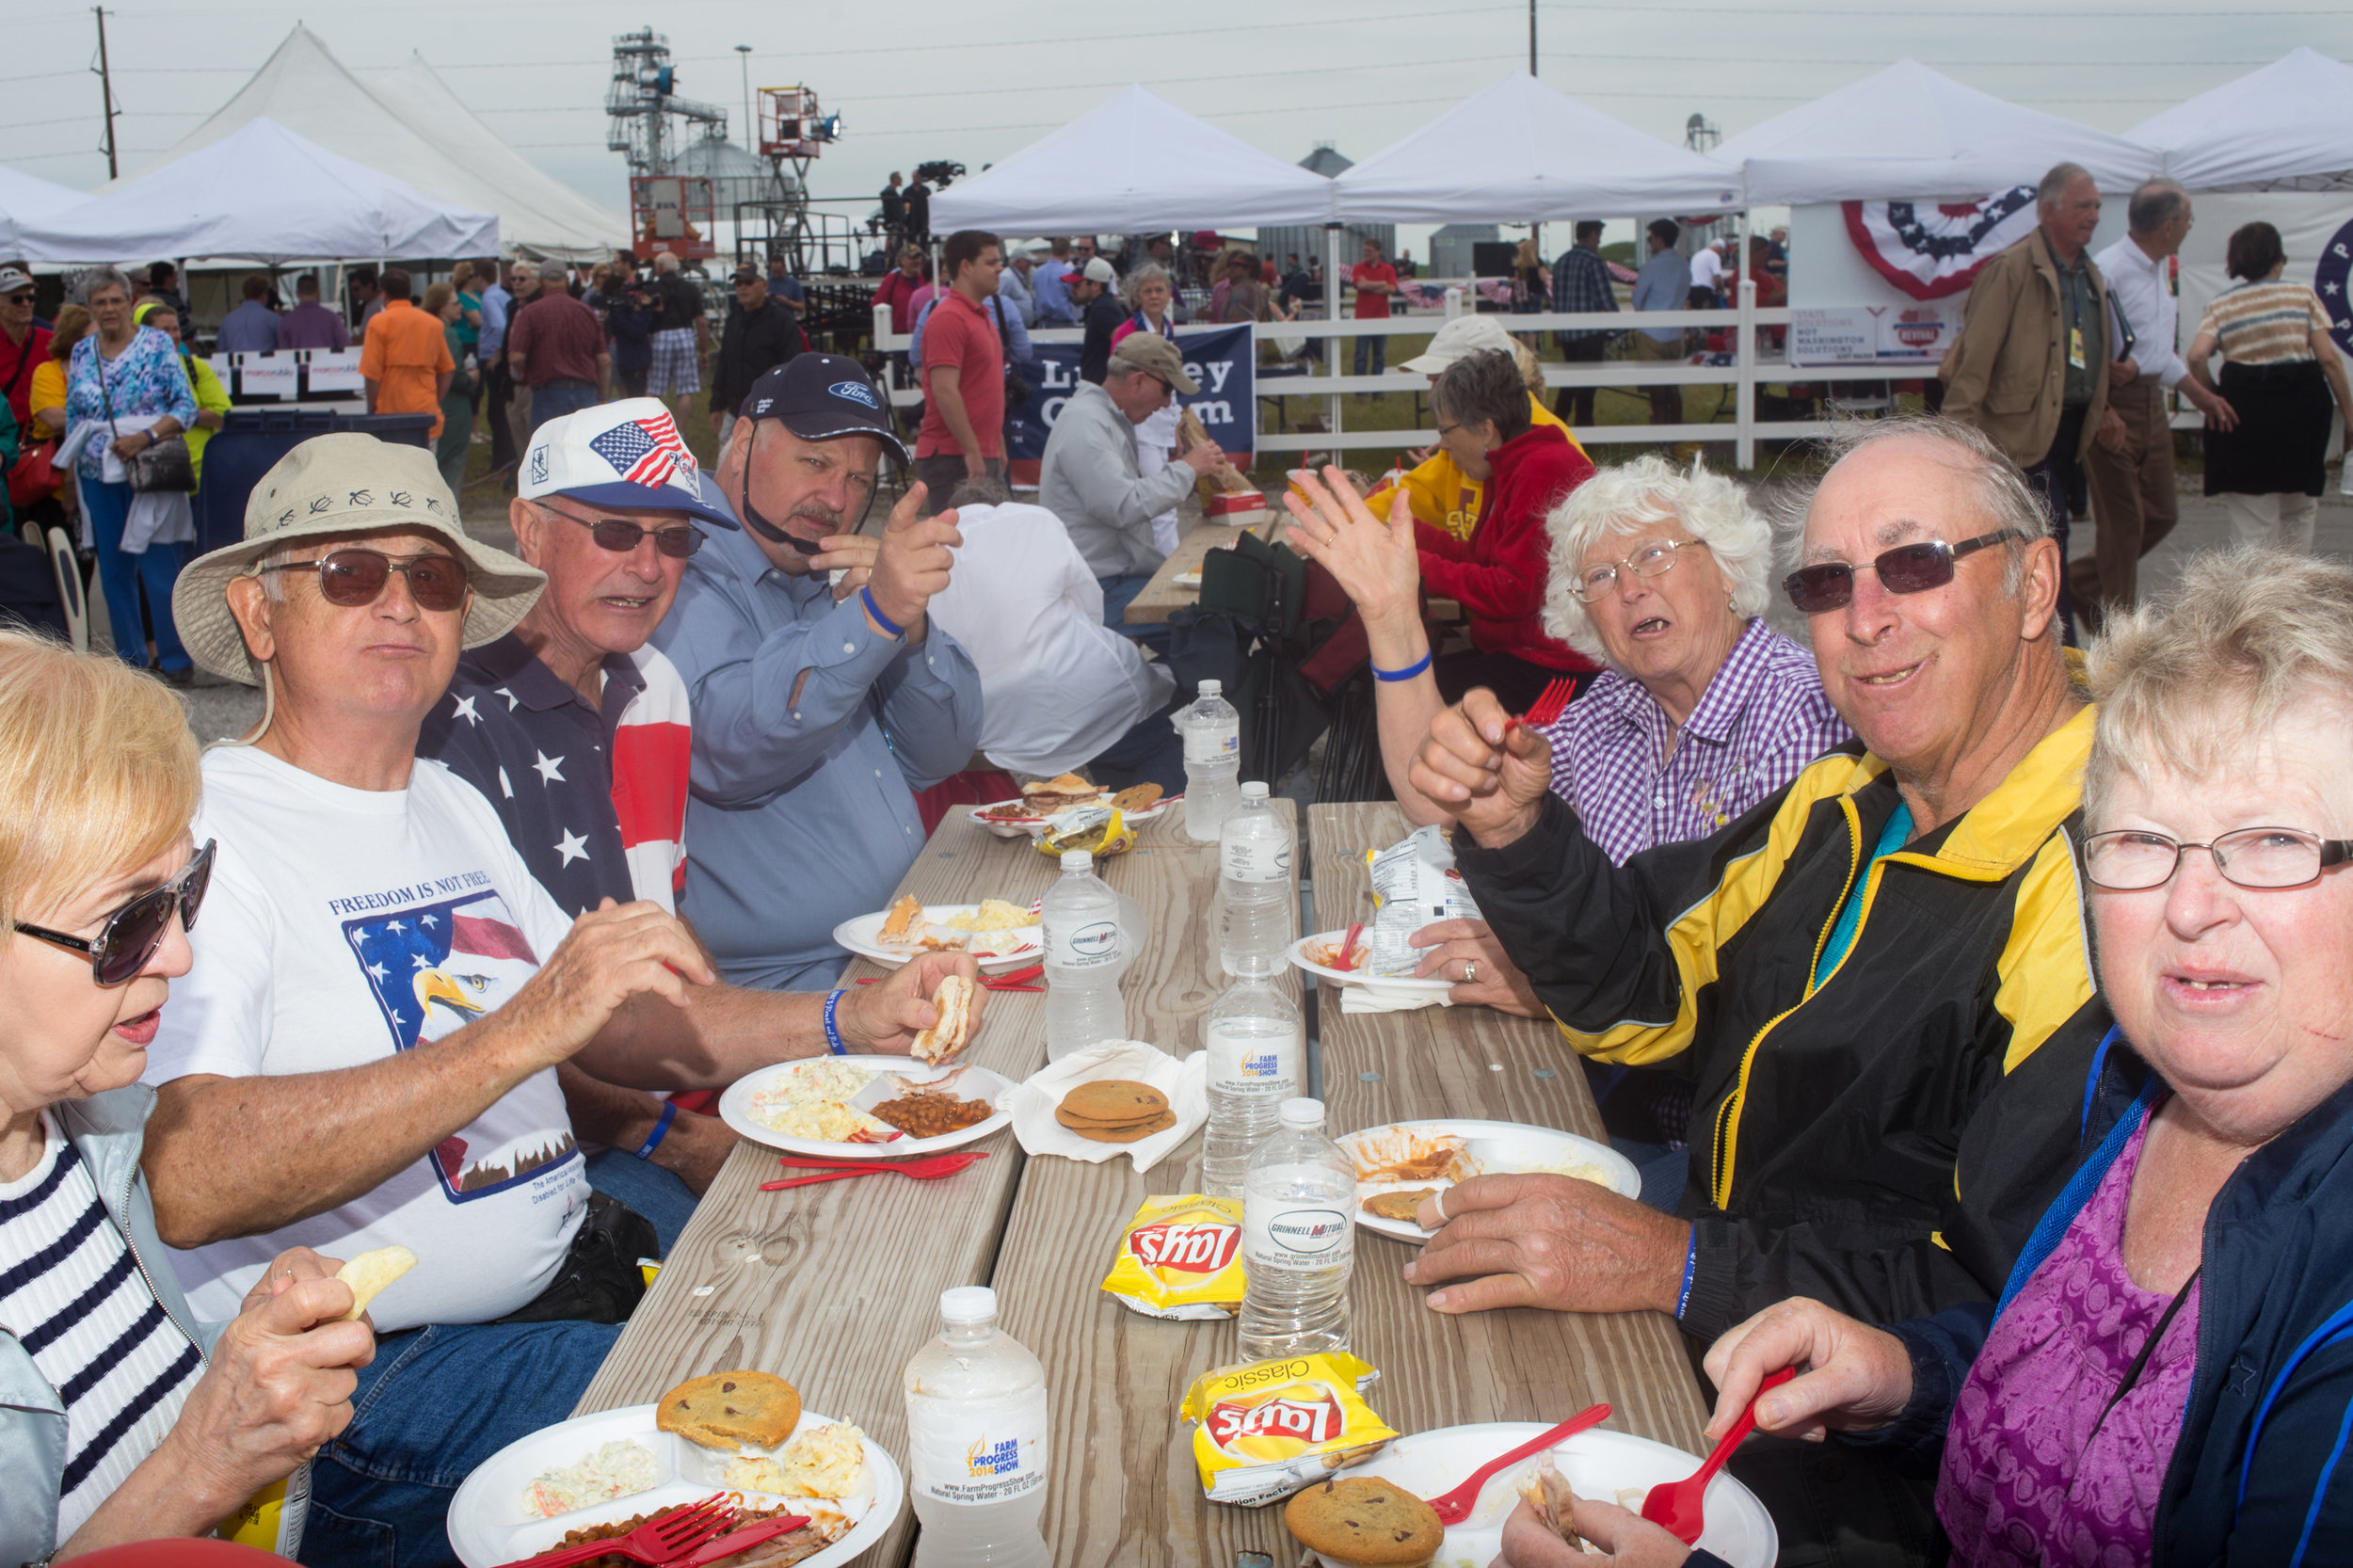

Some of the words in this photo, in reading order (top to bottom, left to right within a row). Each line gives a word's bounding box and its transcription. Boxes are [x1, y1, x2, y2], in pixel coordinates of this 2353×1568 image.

[1797, 328, 1817, 336] NOT
[1797, 336, 1865, 344] WASHINGTON
[840, 382, 872, 405] Ford
[328, 887, 415, 916] FREEDOM
[416, 882, 434, 899] IS
[435, 876, 463, 895] NOT
[461, 870, 491, 888] FREE
[1244, 1061, 1278, 1070] PROGRESS
[1259, 1054, 1278, 1064] FARM
[532, 1180, 545, 1191] The
[532, 1186, 557, 1205] Disabled
[1160, 1200, 1232, 1213] Classic
[1271, 1223, 1311, 1236] GRINNELL
[1309, 1221, 1344, 1237] MUTUAL
[1140, 1223, 1237, 1270] Lay's
[1273, 1248, 1341, 1260] www.grinnellmutual.com
[1255, 1250, 1273, 1261] Natural
[1273, 1256, 1292, 1267] Spring
[1292, 1258, 1310, 1267] Water
[1224, 1360, 1309, 1390] Classic
[1216, 1398, 1331, 1442] Lay's
[994, 1438, 1018, 1454] FARM
[973, 1448, 1018, 1467] PROGRESS
[943, 1471, 1035, 1493] www.FarmProgressShow.com
[930, 1485, 952, 1498] Natural
[952, 1491, 975, 1502] Spring
[976, 1490, 998, 1500] Water
[1003, 1486, 1013, 1496] 20
[1013, 1484, 1021, 1493] FL
[1021, 1481, 1030, 1491] OZ
[1258, 1485, 1289, 1500] Facts
